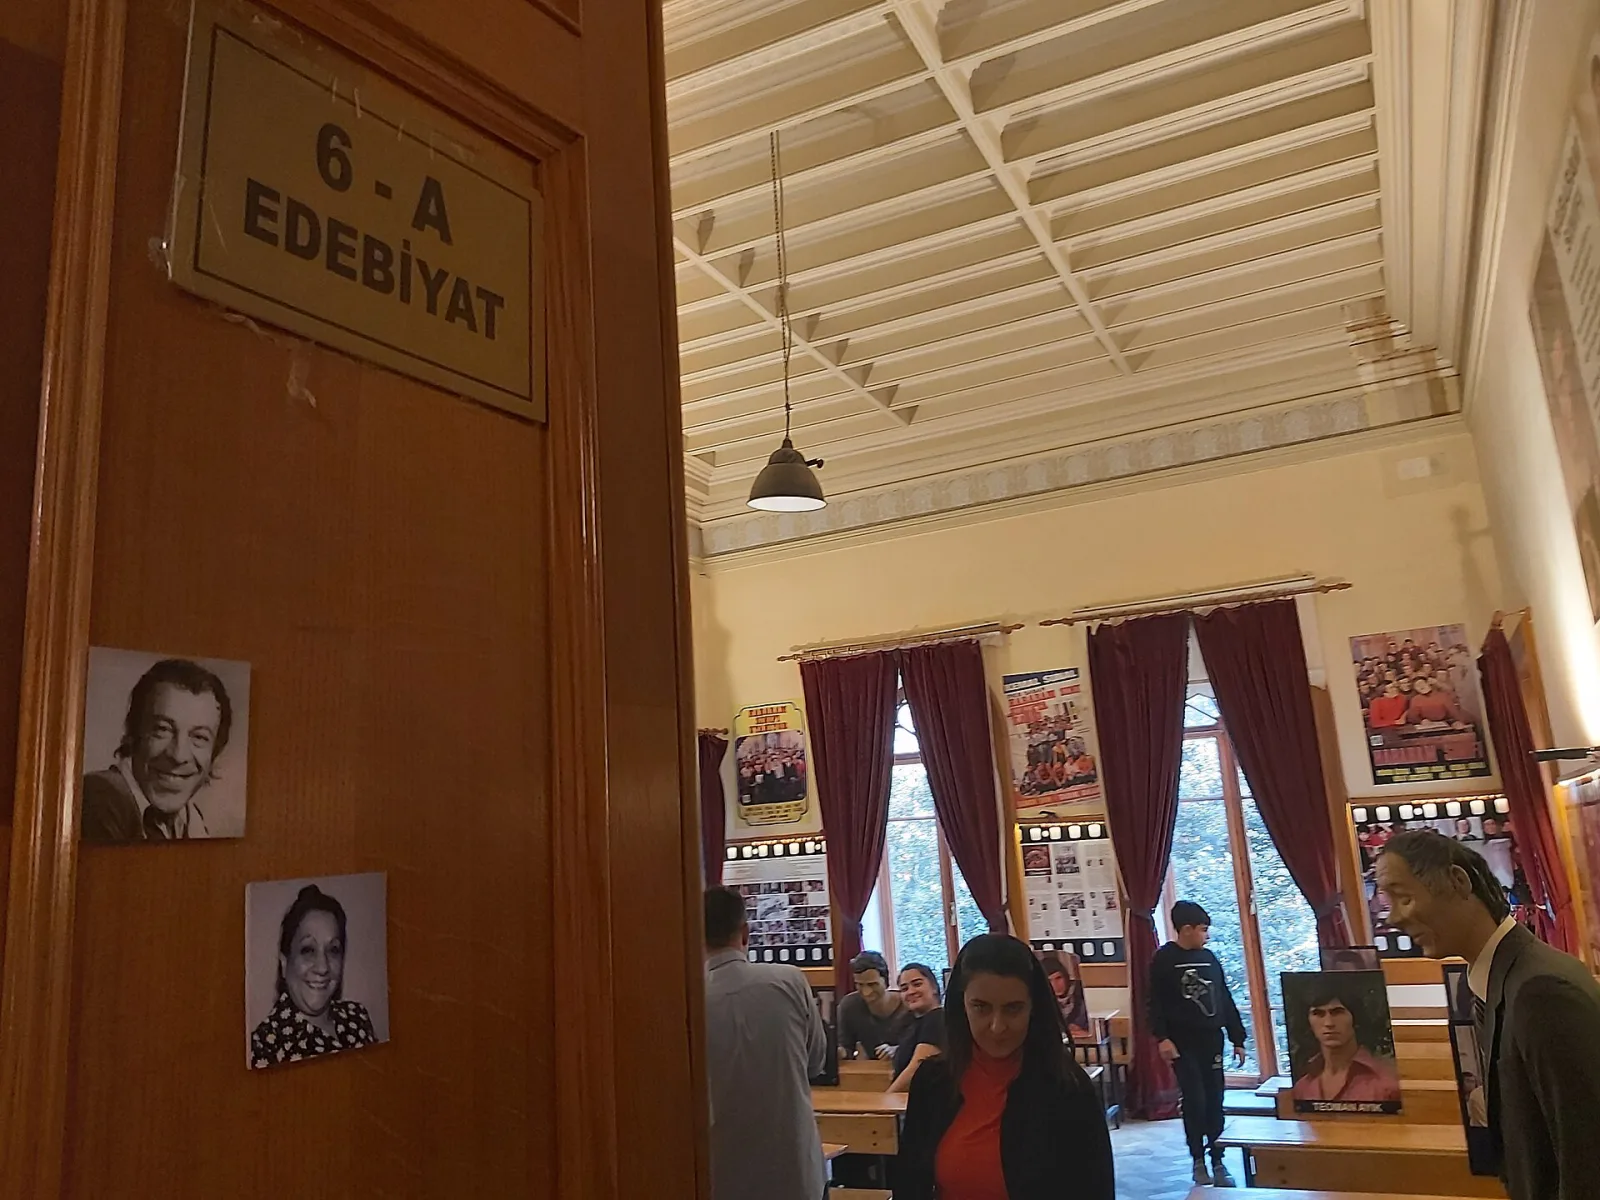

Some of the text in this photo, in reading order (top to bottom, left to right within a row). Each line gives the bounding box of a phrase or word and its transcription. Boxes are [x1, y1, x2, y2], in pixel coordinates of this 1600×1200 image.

[316, 122, 353, 192] 6
[412, 176, 452, 246] A
[243, 177, 505, 341] EDEBİYAT
